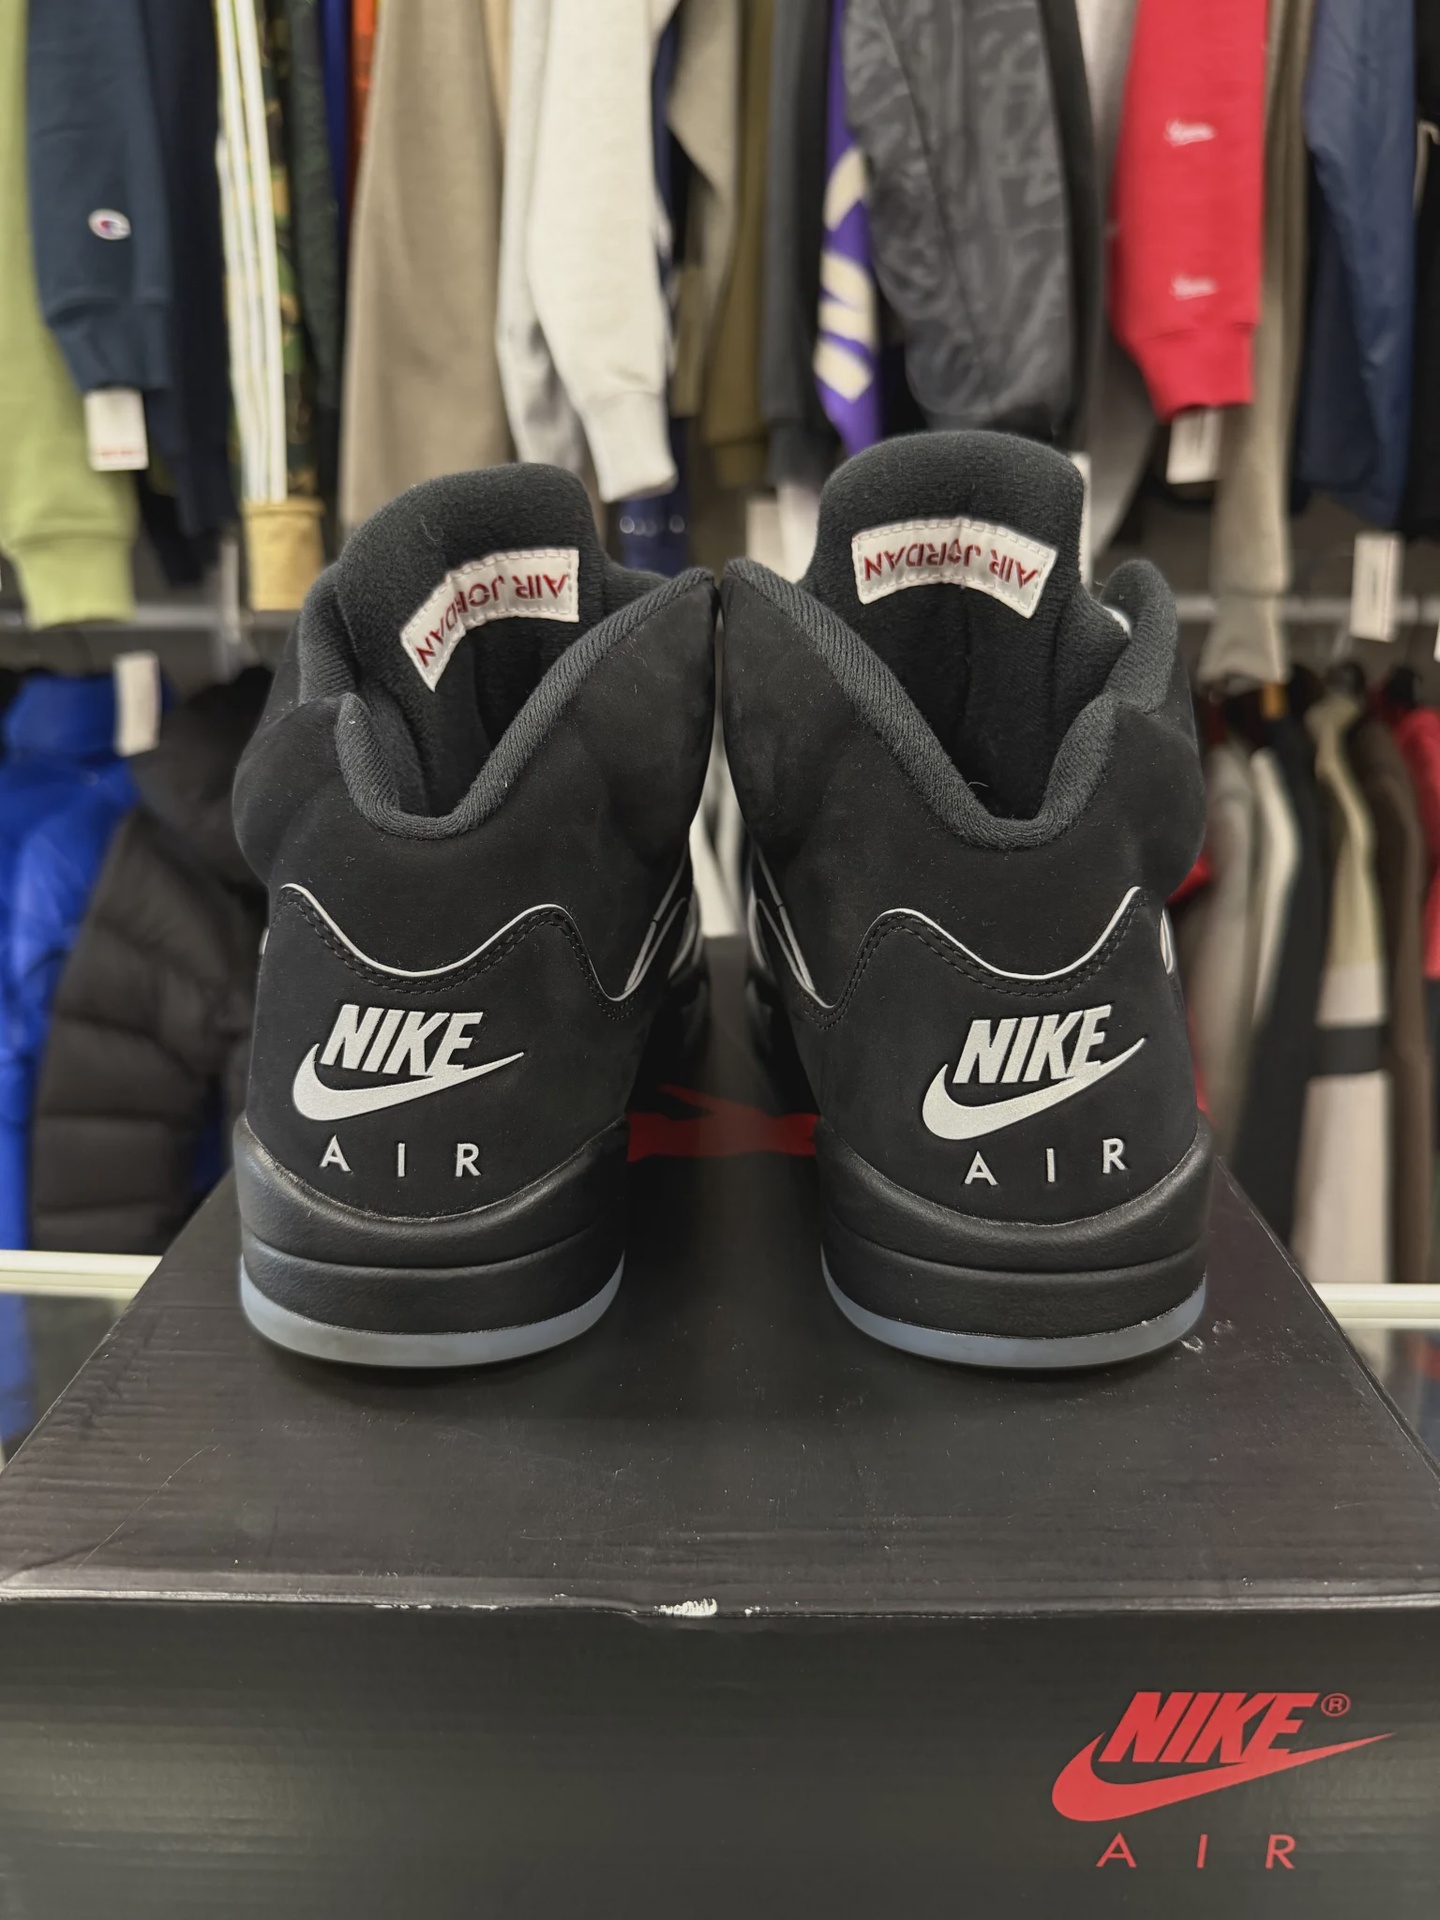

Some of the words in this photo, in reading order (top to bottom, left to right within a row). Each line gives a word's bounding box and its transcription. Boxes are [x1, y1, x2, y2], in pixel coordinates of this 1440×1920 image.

[864, 538, 981, 581] JORDAN
[989, 549, 1038, 589] AIR
[512, 574, 568, 599] AIR
[320, 1004, 483, 1076] NIKE
[953, 1004, 1112, 1082] NIKE
[320, 1135, 482, 1178] AIR
[964, 1138, 1127, 1186] AIR
[1096, 1832, 1296, 1869] AIR
